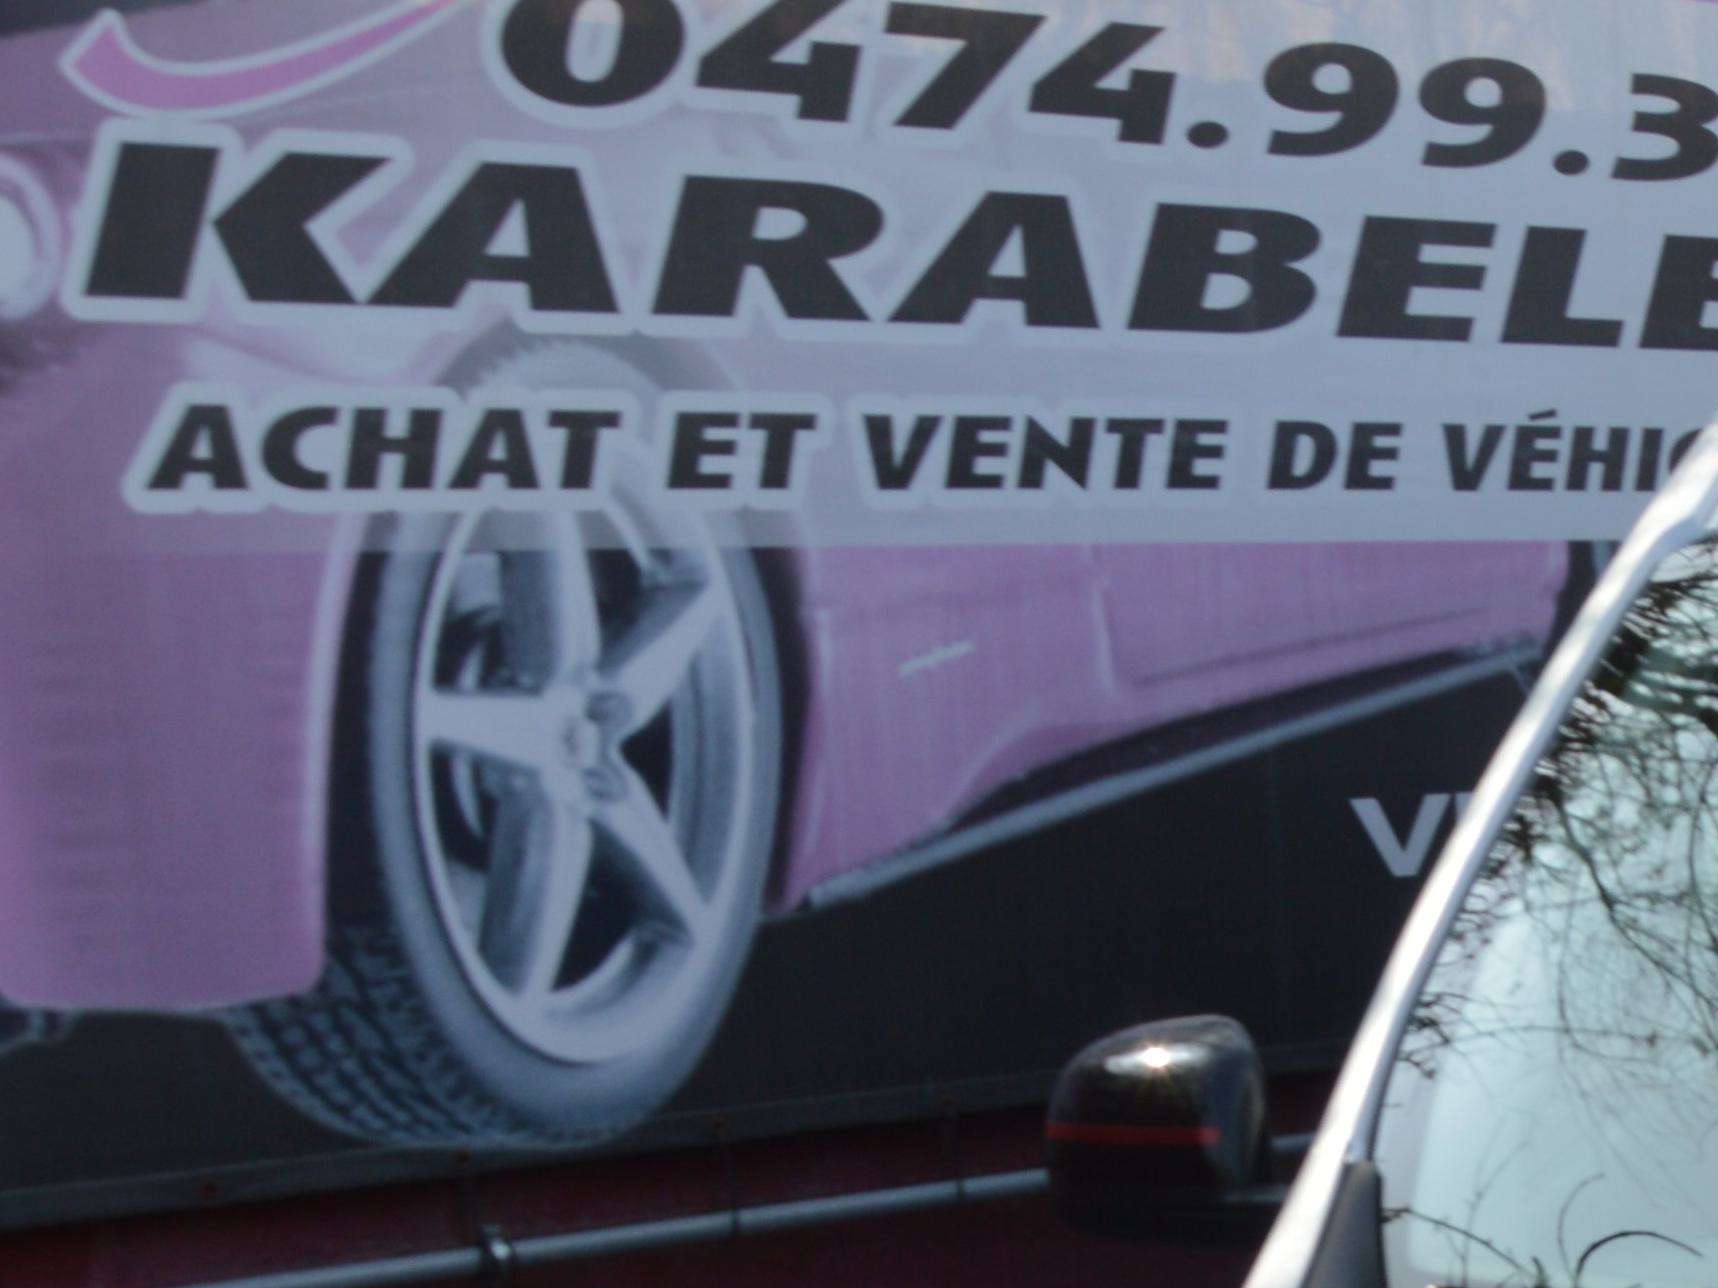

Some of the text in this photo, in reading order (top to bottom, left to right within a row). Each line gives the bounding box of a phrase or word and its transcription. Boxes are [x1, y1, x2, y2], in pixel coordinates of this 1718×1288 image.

[145, 403, 620, 492] ACHAT
[666, 410, 817, 491] ET
[861, 413, 1228, 492] VENTE
[1266, 419, 1404, 491] DE
